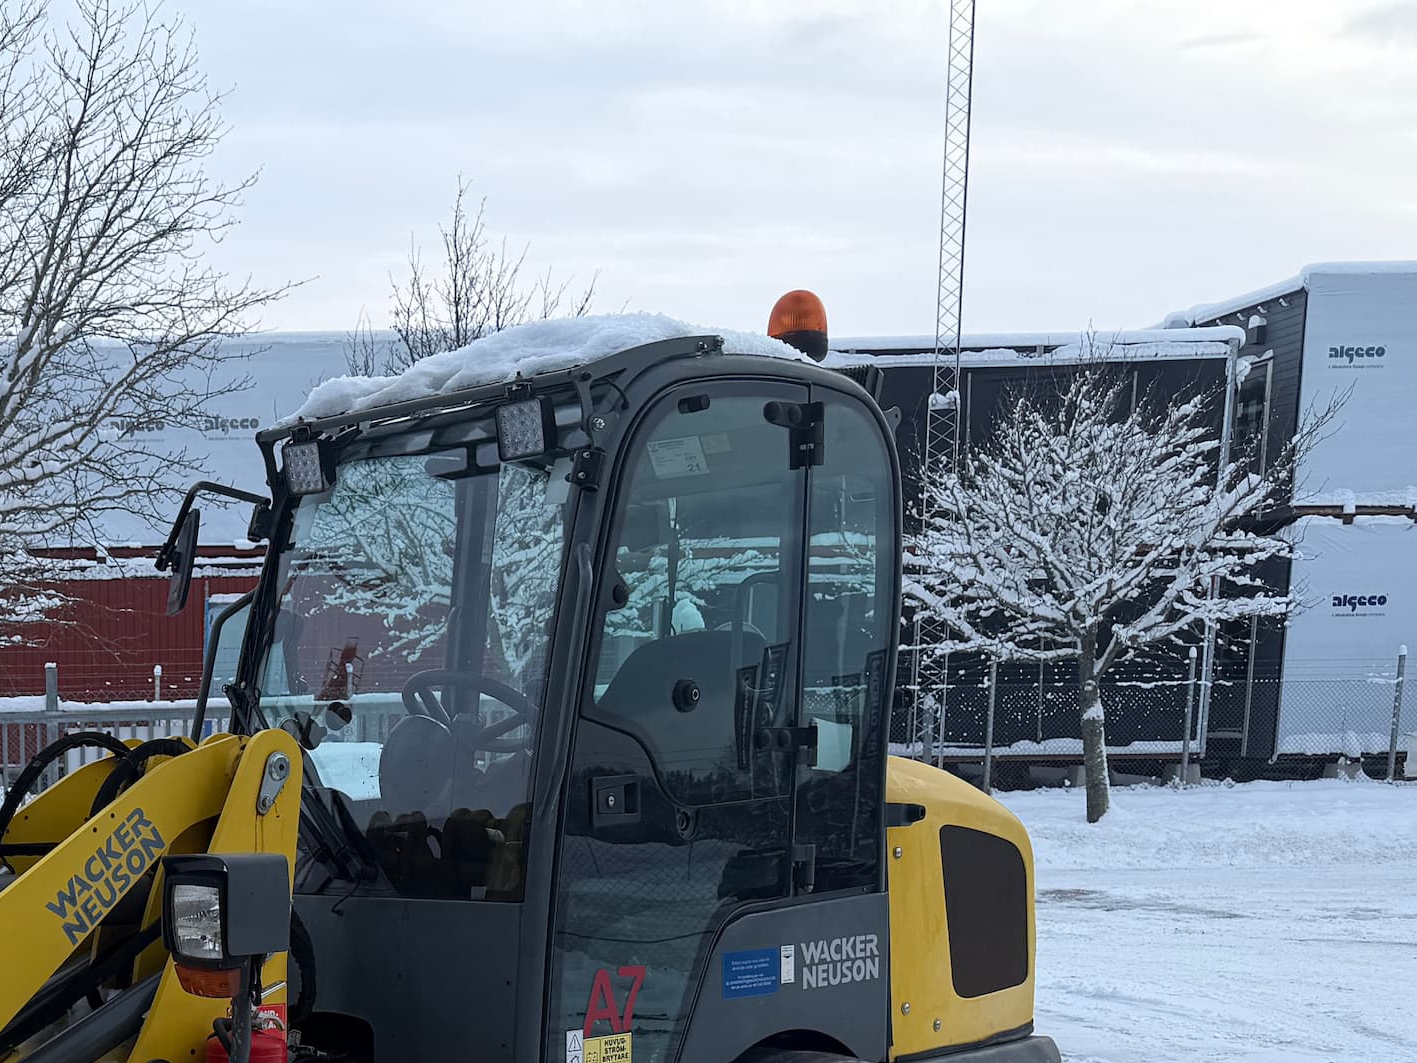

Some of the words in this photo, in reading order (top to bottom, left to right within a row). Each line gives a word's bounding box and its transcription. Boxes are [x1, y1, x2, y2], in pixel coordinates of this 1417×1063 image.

[45, 807, 152, 919] WACKER
[62, 826, 166, 945] NEUSON
[800, 934, 880, 965] WACKER
[802, 957, 880, 990] NEUSON
[583, 966, 647, 1039] A7
